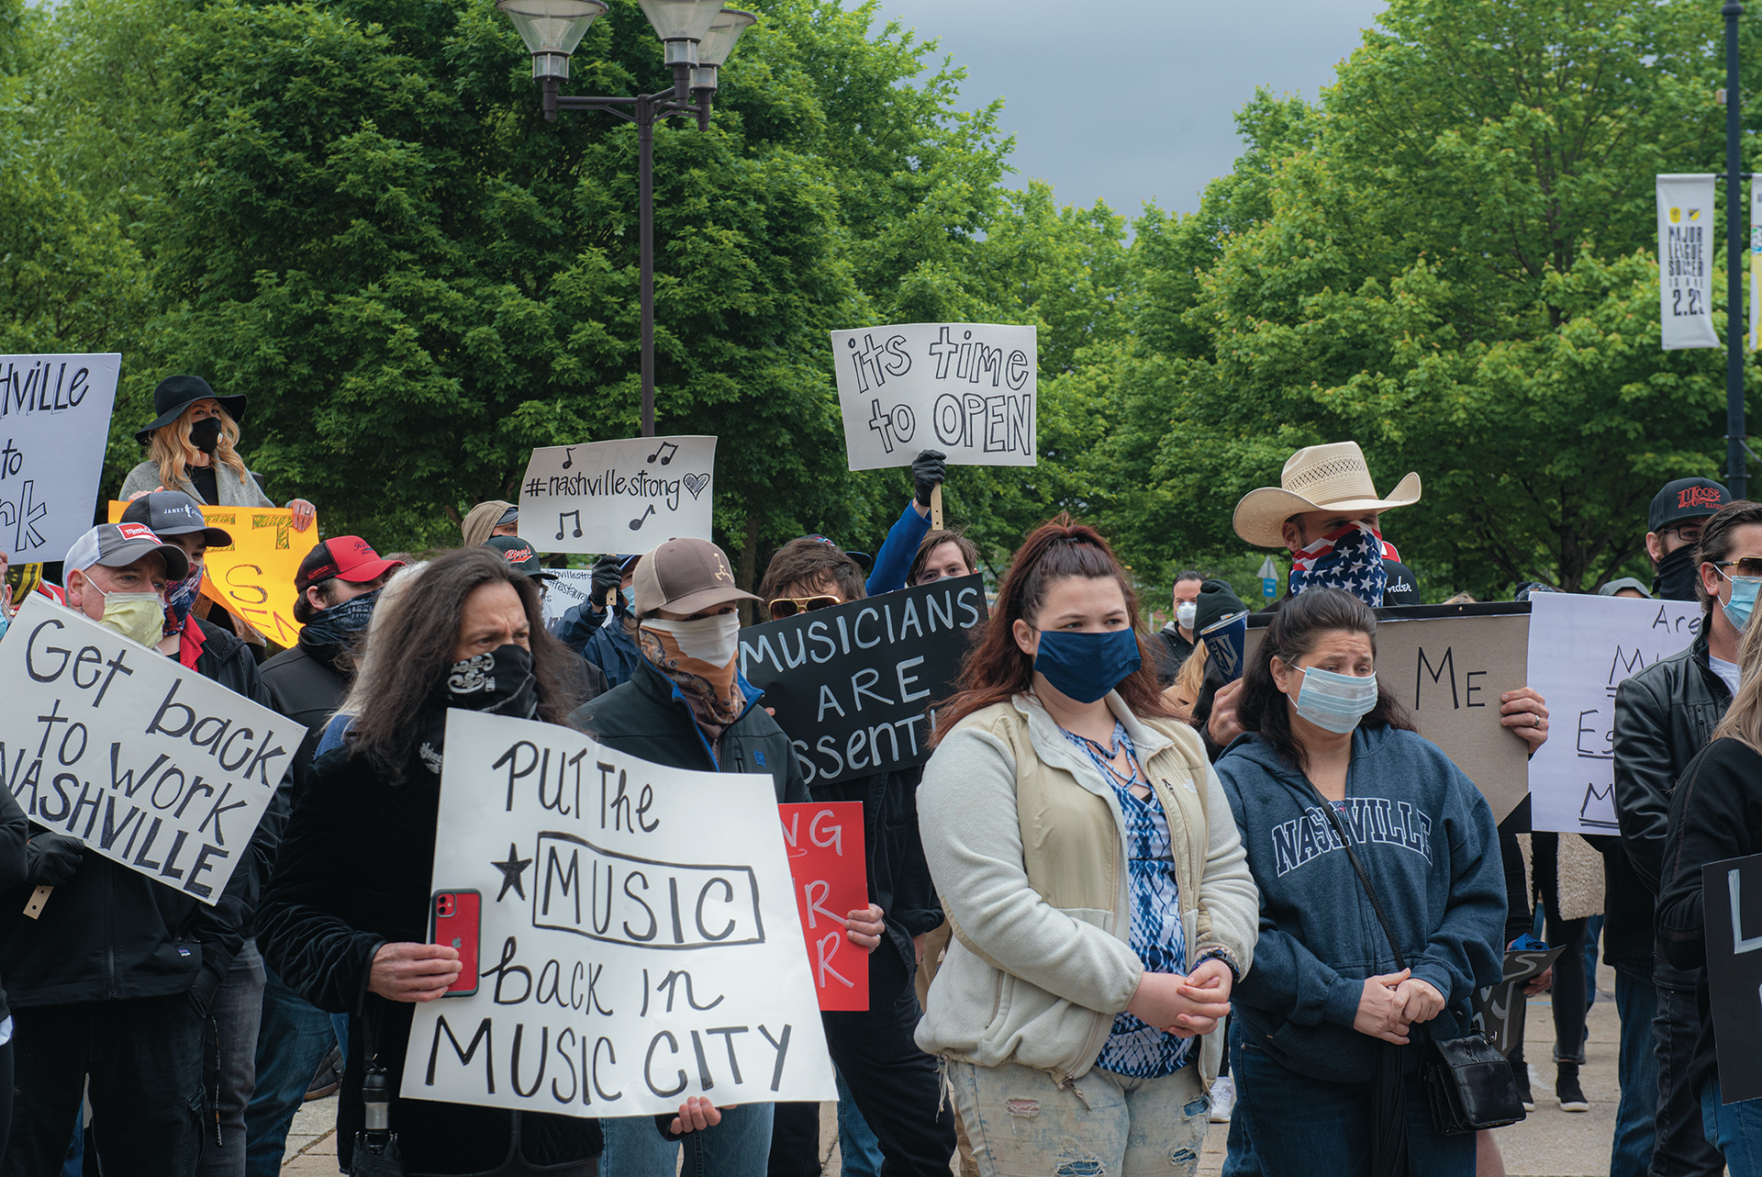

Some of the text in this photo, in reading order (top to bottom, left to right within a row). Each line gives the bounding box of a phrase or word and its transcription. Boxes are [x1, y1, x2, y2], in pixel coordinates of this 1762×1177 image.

[1668, 226, 1703, 242] MAJOR
[1668, 243, 1703, 260] LEAGUE
[1668, 260, 1704, 276] SOCCER
[929, 326, 1029, 390] time
[868, 393, 1031, 456] to OPEN
[1, 438, 23, 481] to
[524, 468, 680, 512] #nashvillestrong
[739, 587, 979, 680] MUSICIANS
[25, 619, 287, 788] Get back
[817, 655, 931, 722] ARE
[37, 699, 88, 766] to
[0, 740, 230, 899] NASHVILLE
[491, 740, 588, 820] PUT
[596, 760, 660, 834] The
[1271, 796, 1434, 878] NASHVILLE
[541, 845, 736, 944] MUSIC
[481, 936, 614, 1017] back
[425, 1014, 792, 1106] MUSIC CITY
